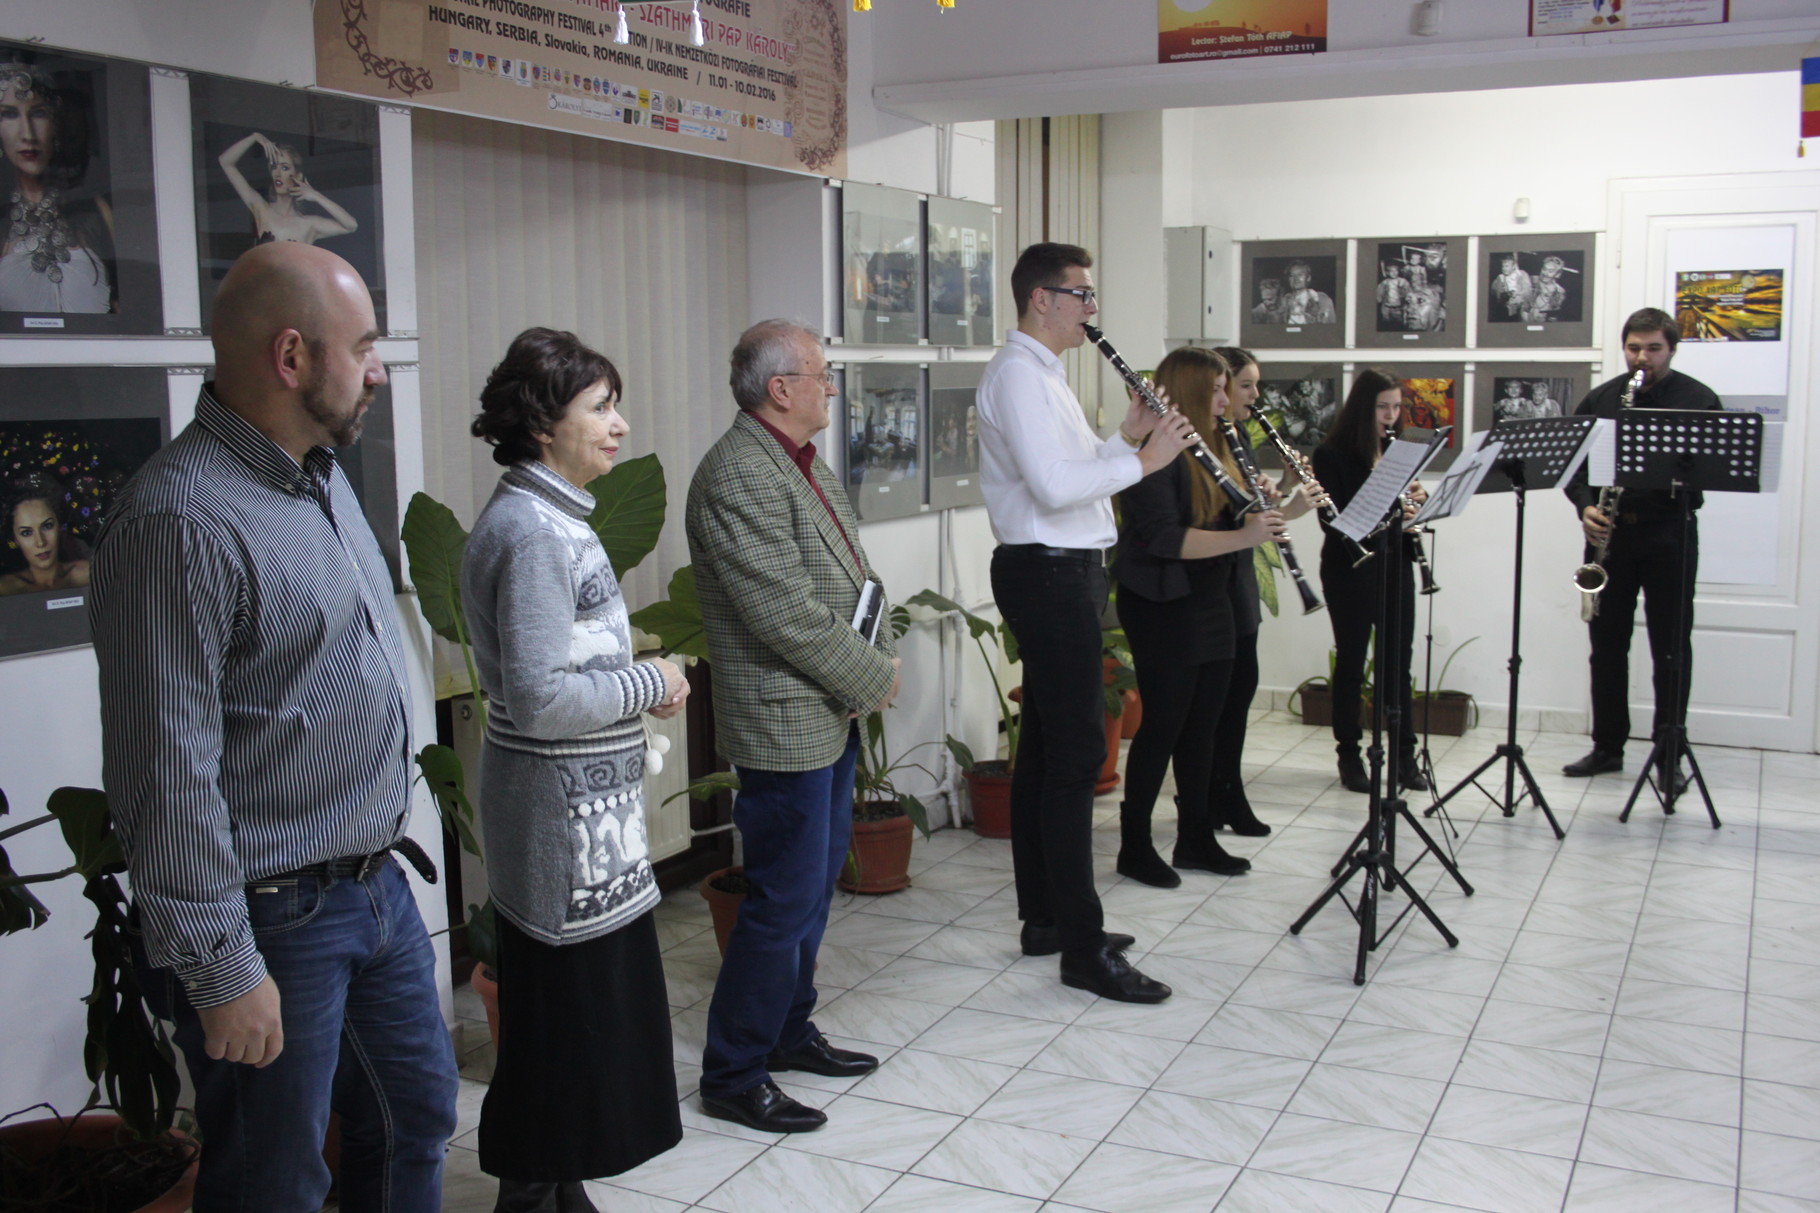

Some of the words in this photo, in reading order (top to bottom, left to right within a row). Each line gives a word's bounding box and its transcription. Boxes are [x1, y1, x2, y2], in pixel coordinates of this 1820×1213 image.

[557, 12, 597, 36] FESTIVAL
[598, 23, 612, 38] 4th
[656, 38, 673, 56] IV-IK
[675, 44, 720, 68] NEMZETKÖZI
[639, 3, 714, 41] SZATHMRI
[718, 23, 742, 47] PAP
[1191, 37, 1217, 46] Lector:
[428, 5, 493, 36] HUNGARY,
[496, 21, 541, 47] SERBIA,
[545, 33, 590, 58] Slovakia,
[593, 45, 644, 71] ROMANIA,
[646, 58, 688, 80] UKRAINE
[708, 73, 728, 90] 11.01
[734, 80, 776, 101] 10.02.2016
[1264, 46, 1283, 54] 0741
[1301, 43, 1316, 51] 111
